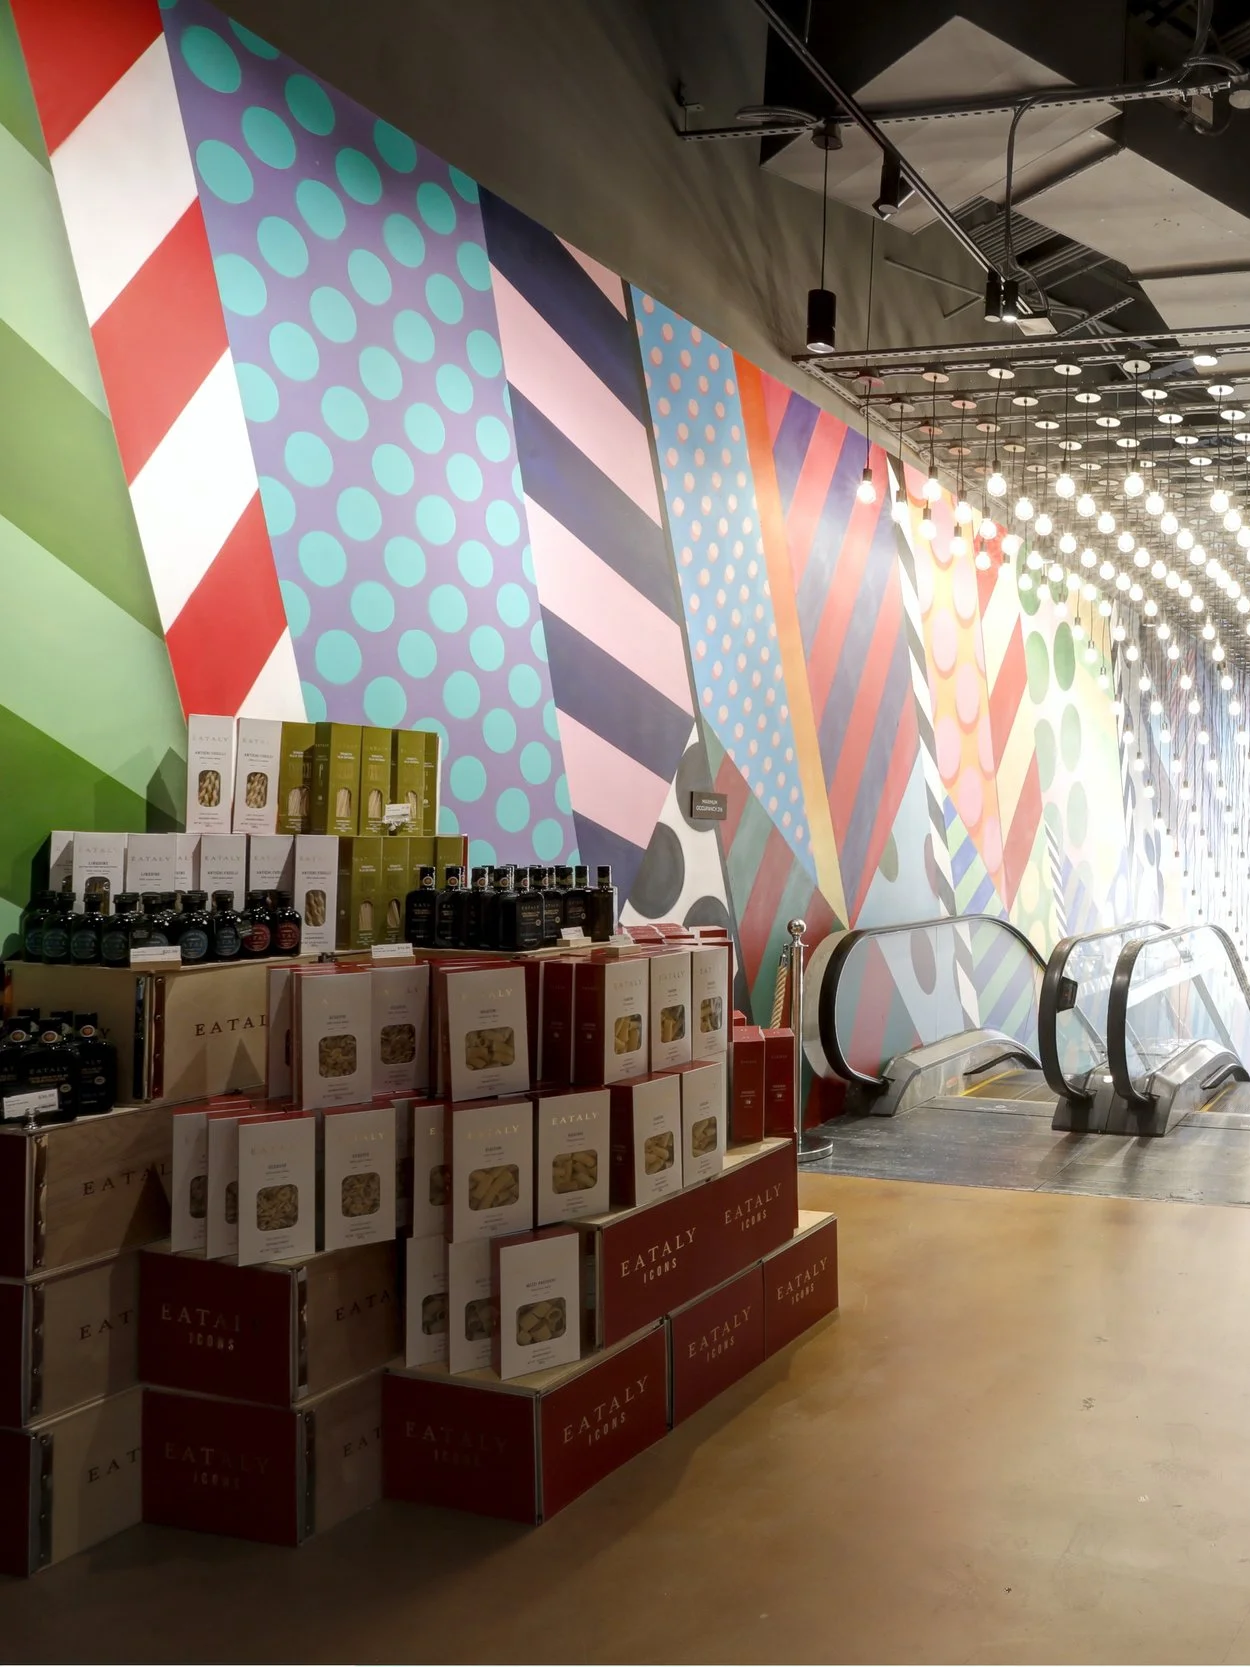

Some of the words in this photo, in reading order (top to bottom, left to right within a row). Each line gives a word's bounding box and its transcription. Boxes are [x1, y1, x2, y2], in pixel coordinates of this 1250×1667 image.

[195, 1014, 268, 1037] EATAL
[551, 1111, 600, 1126] EATALY
[83, 1163, 172, 1196] EATAL
[724, 1182, 782, 1225] EATALY
[741, 1209, 768, 1232] ICONS
[620, 1226, 698, 1278] EATALY
[643, 1257, 677, 1284] ICONS
[776, 1256, 828, 1301] EATALY
[335, 1289, 390, 1322] EATA
[791, 1282, 815, 1305] ICONS
[79, 1309, 135, 1341] EAT
[161, 1303, 240, 1332] EATAL
[687, 1305, 752, 1360] EATALY
[706, 1335, 736, 1363] ICONS
[562, 1374, 649, 1445] EATALY
[342, 1425, 383, 1458] EAT
[588, 1411, 626, 1446] ICONS
[87, 1447, 141, 1484] EAT
